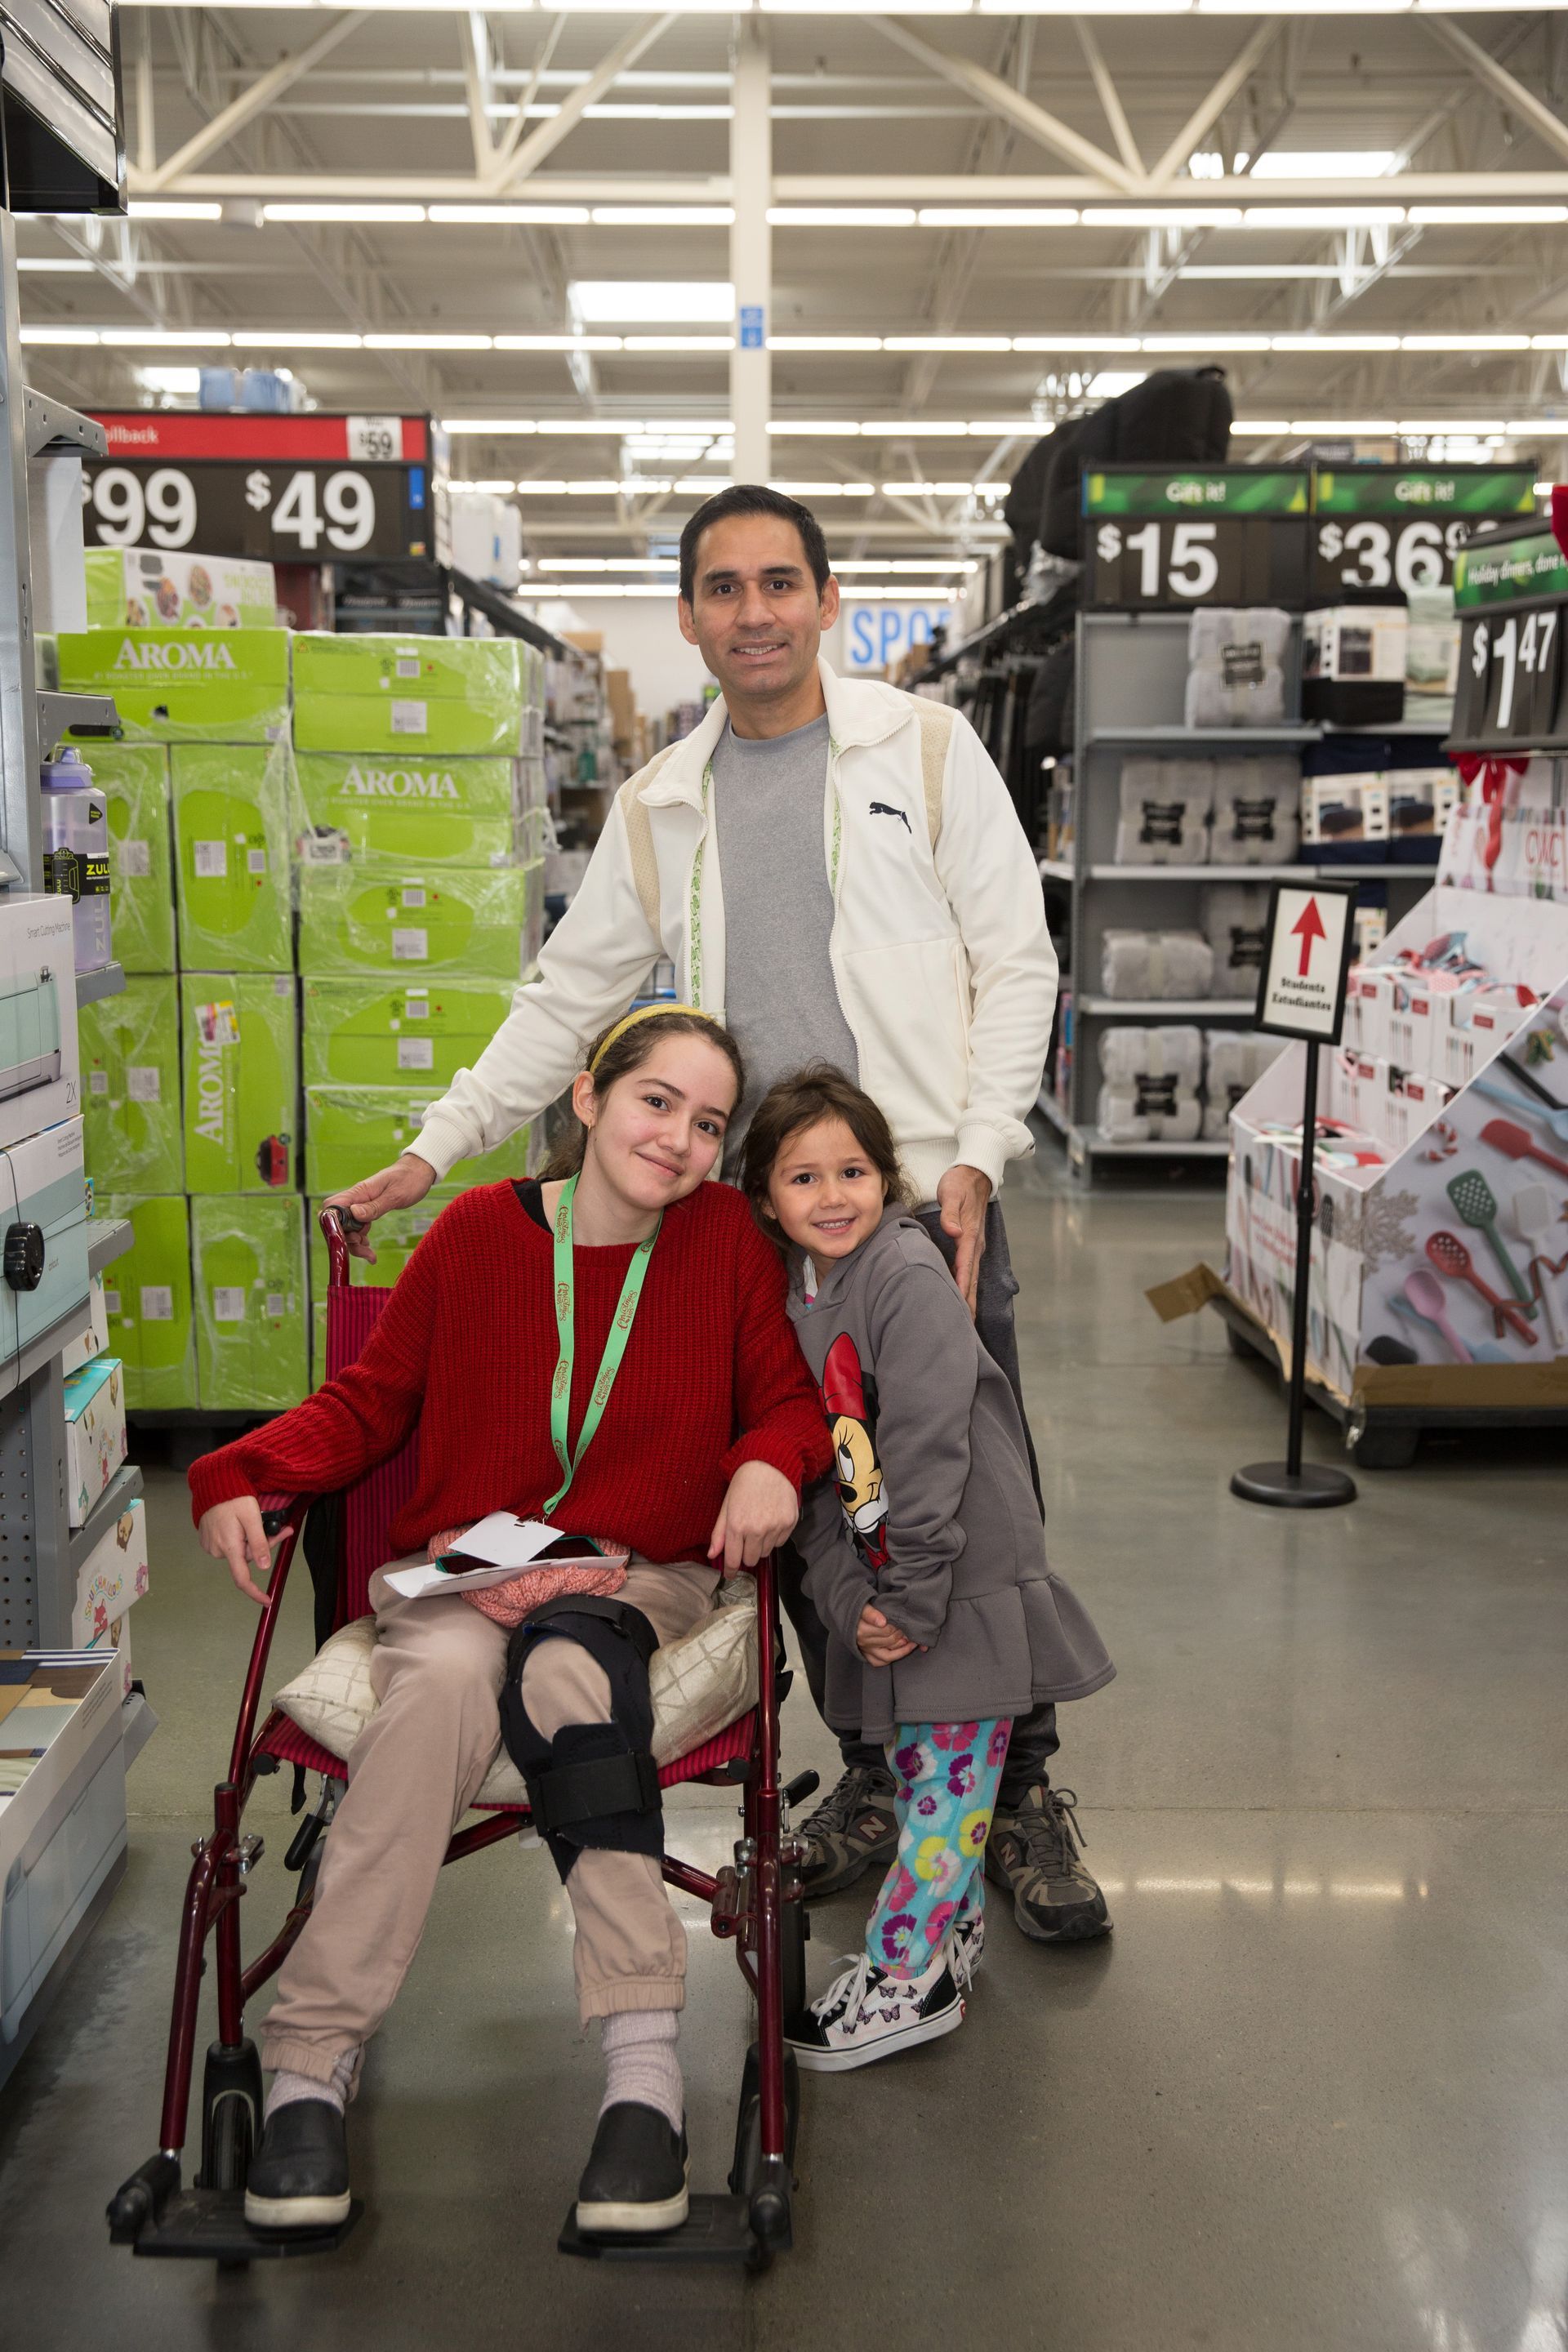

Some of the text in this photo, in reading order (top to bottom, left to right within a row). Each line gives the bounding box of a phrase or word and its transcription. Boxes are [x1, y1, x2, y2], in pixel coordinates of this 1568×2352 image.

[1165, 481, 1226, 502] Gift it!
[1395, 480, 1455, 501] Gift it!
[246, 470, 375, 551] $49
[1097, 523, 1218, 598] $15
[115, 639, 236, 670] AROMA
[341, 764, 460, 800] AROMA
[1281, 977, 1325, 994] Students
[1272, 992, 1332, 1012] Estudiantes
[66, 1080, 77, 1103] 2X
[195, 1038, 224, 1145] AROM
